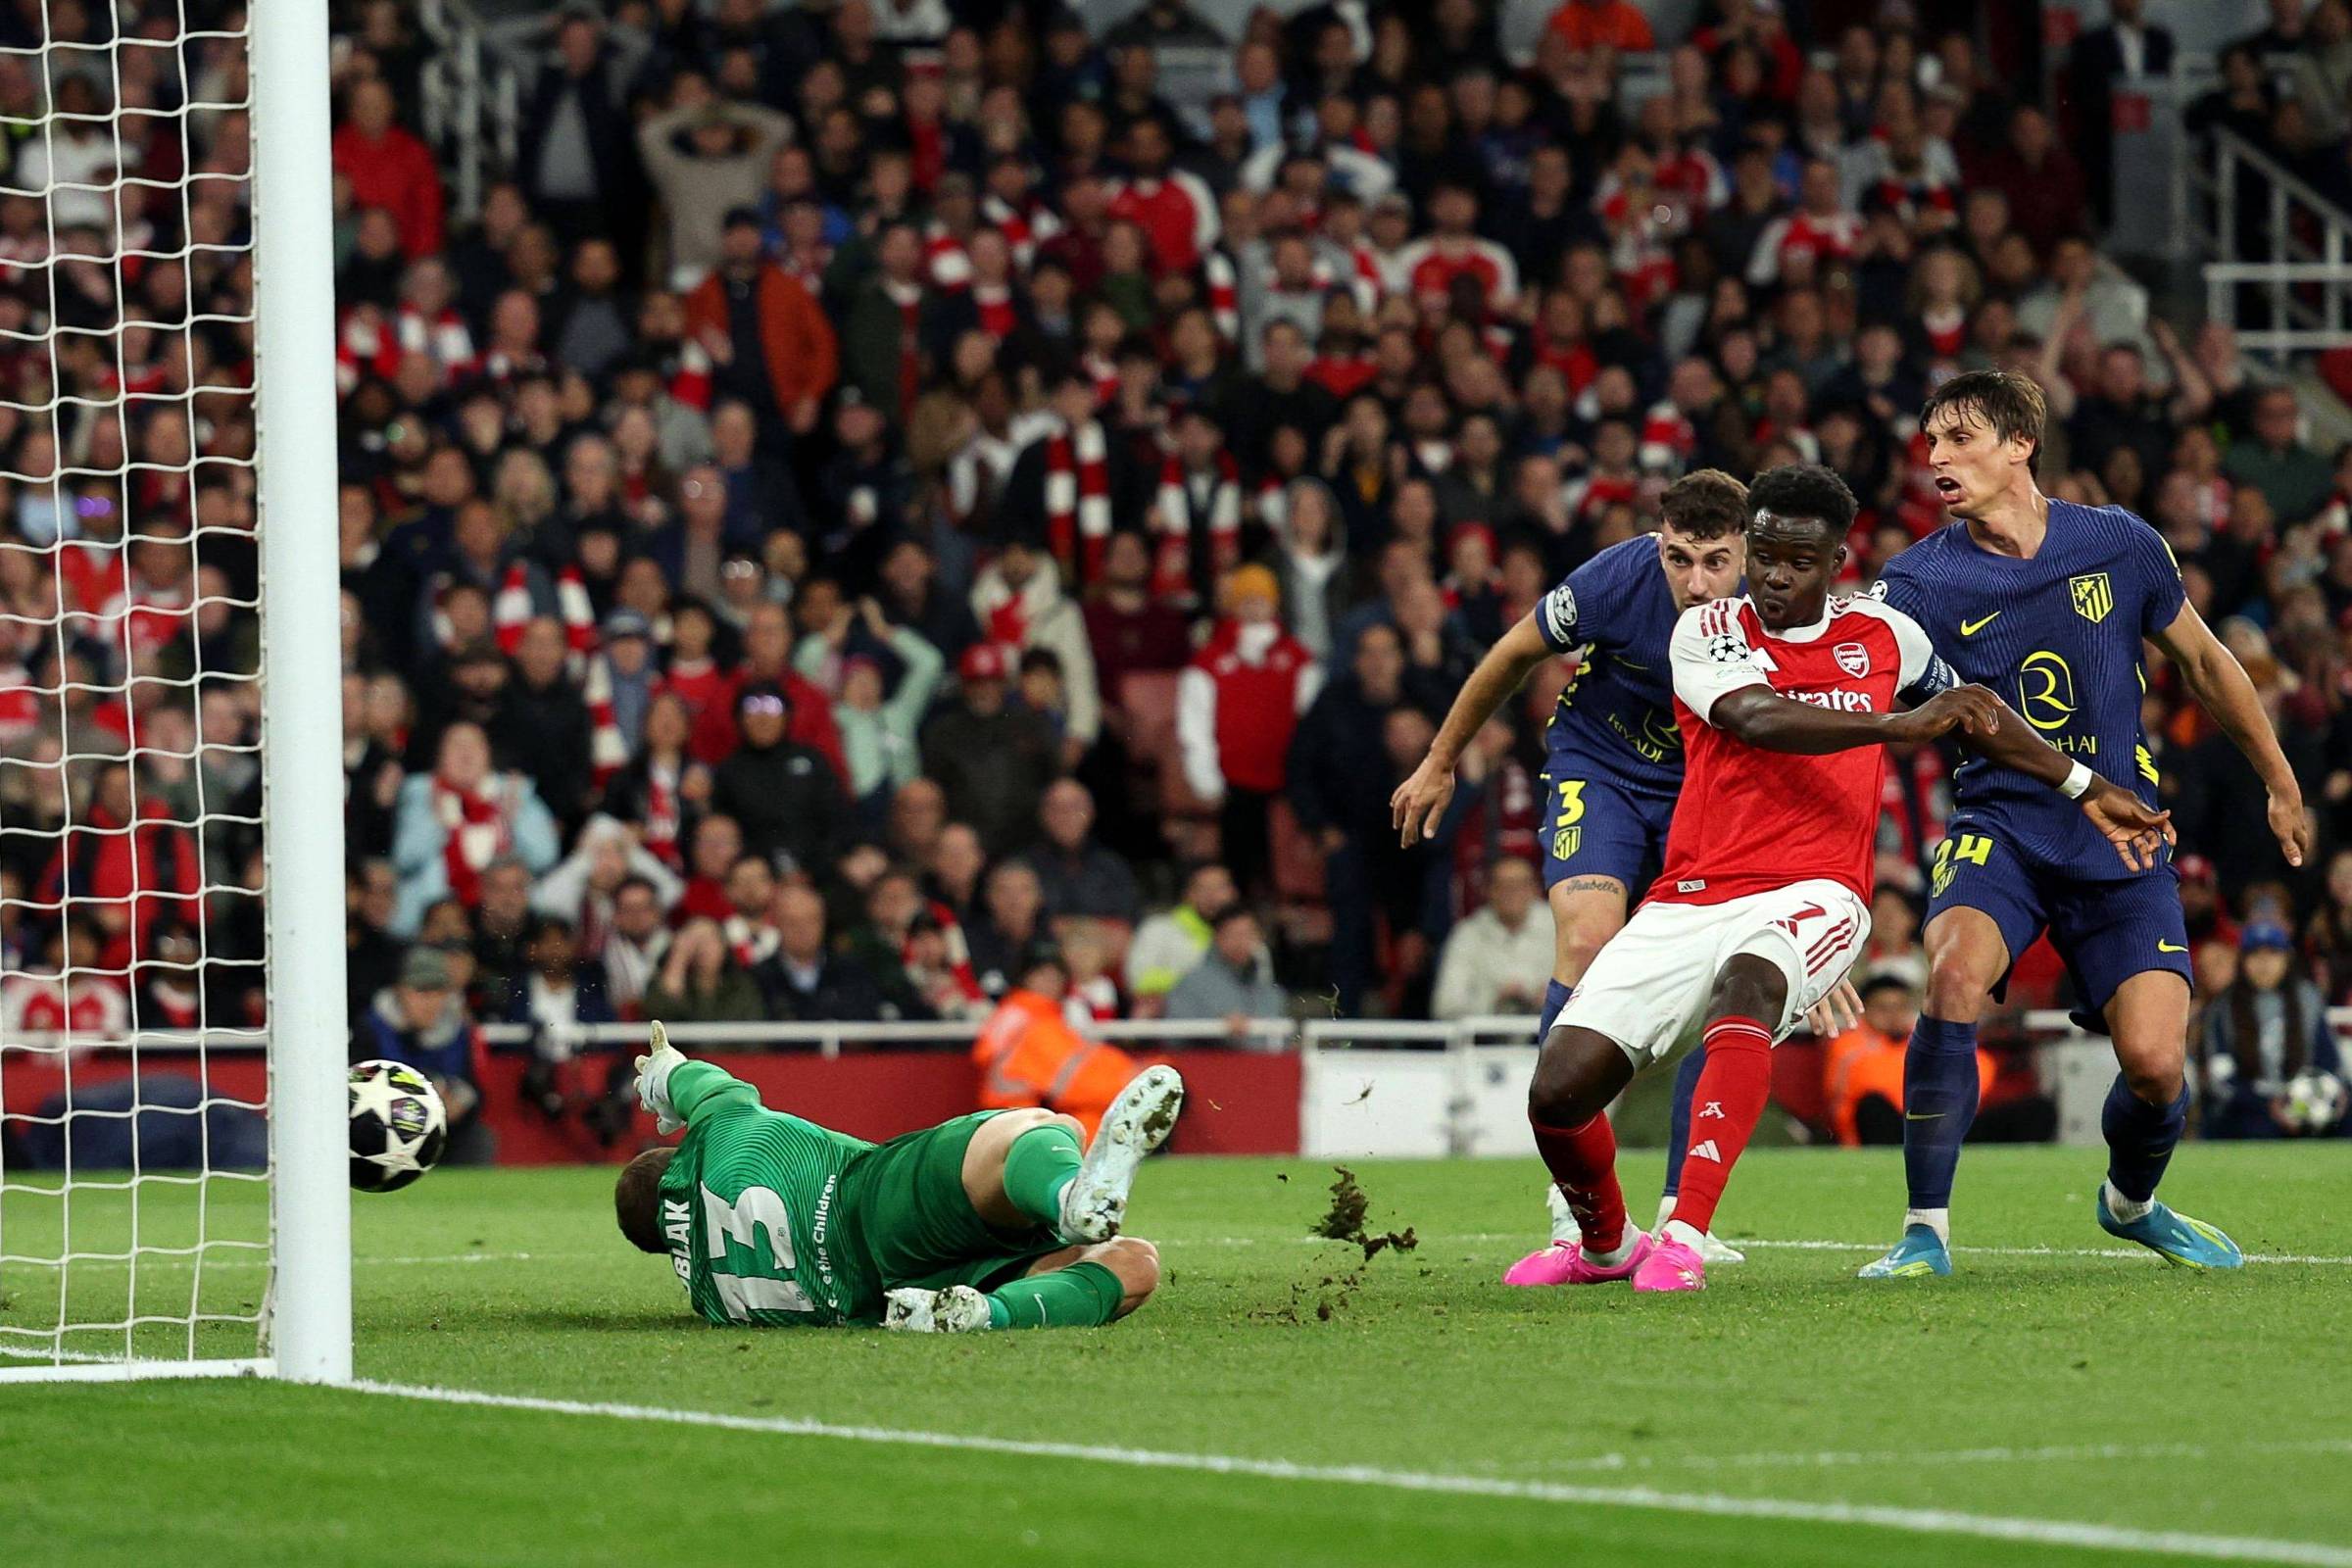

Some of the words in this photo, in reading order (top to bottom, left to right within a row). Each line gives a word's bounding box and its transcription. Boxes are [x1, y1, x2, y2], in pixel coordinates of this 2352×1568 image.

[1776, 686, 1872, 713] irates
[1556, 780, 1587, 827] 3
[1933, 834, 1993, 880] 24
[1788, 901, 1827, 921] 7
[813, 1174, 837, 1245] Children
[664, 1199, 691, 1293] BLAK
[700, 1180, 815, 1322] 13
